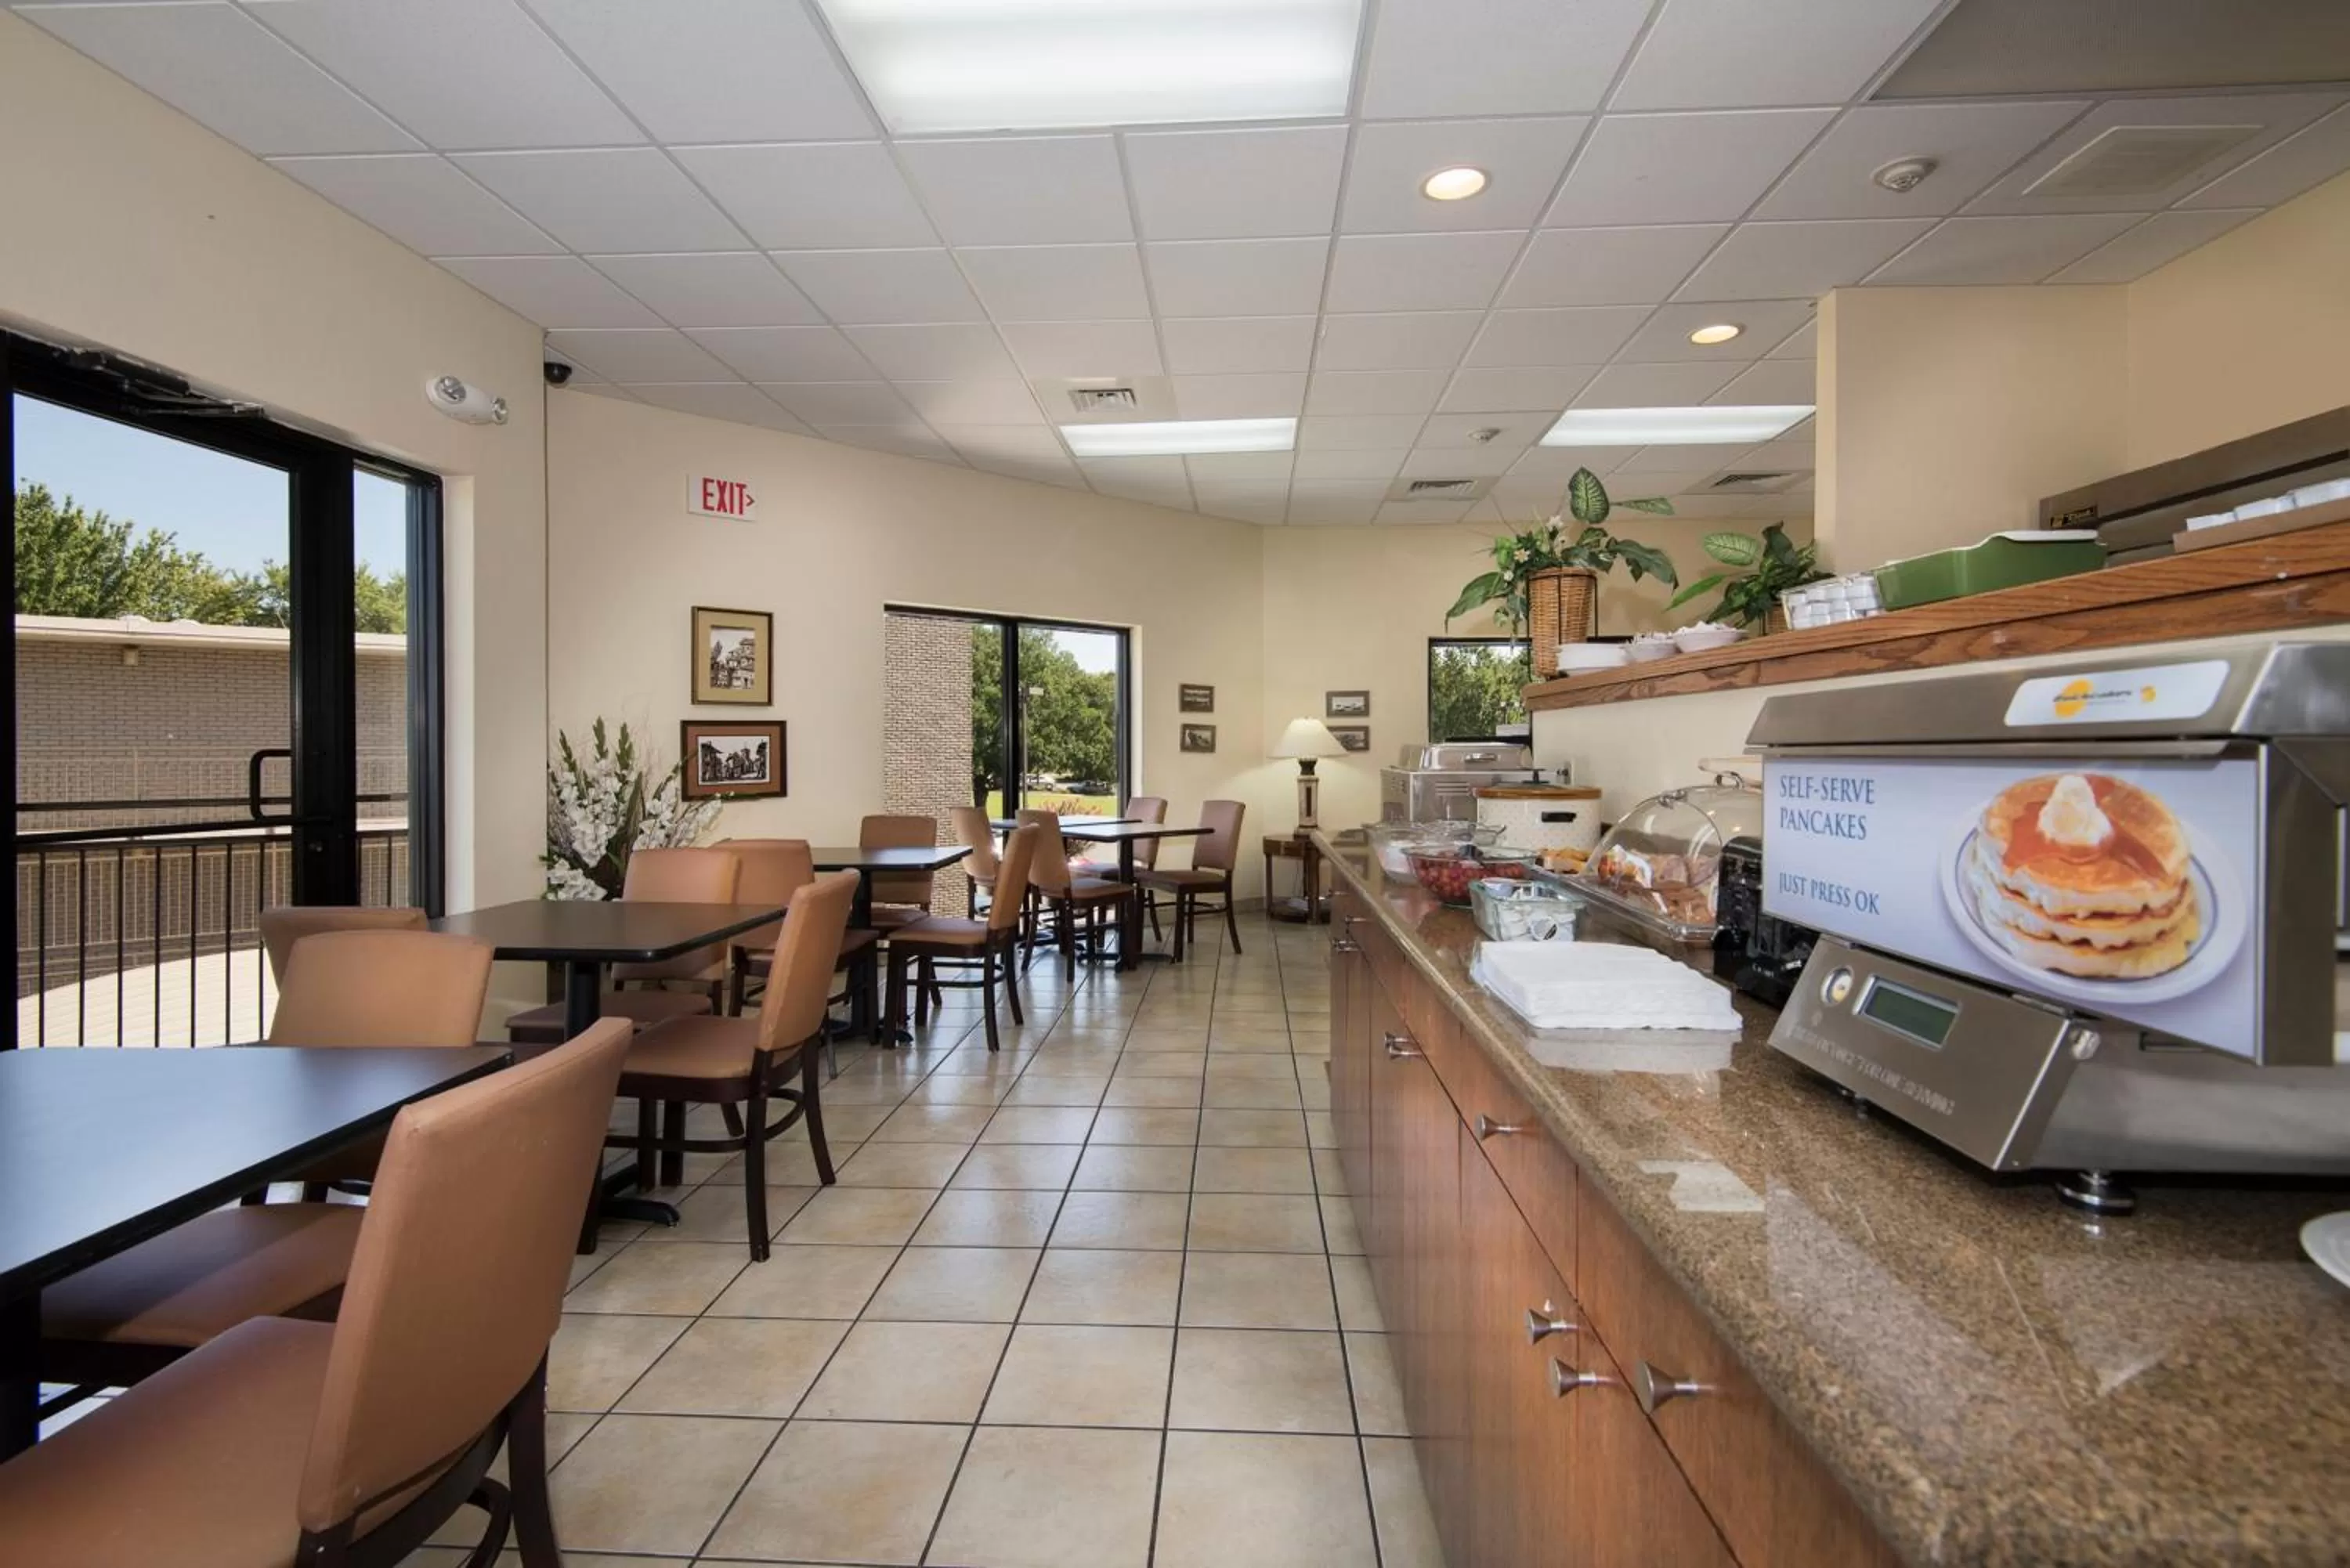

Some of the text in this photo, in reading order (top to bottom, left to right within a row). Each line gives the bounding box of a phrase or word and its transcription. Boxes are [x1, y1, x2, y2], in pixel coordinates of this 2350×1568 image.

[702, 477, 747, 515] EXIT
[1780, 775, 1875, 804] SELF-SERVE
[1780, 807, 1867, 840] PANCAKES
[1779, 871, 1880, 915] JUST PRESS OK
